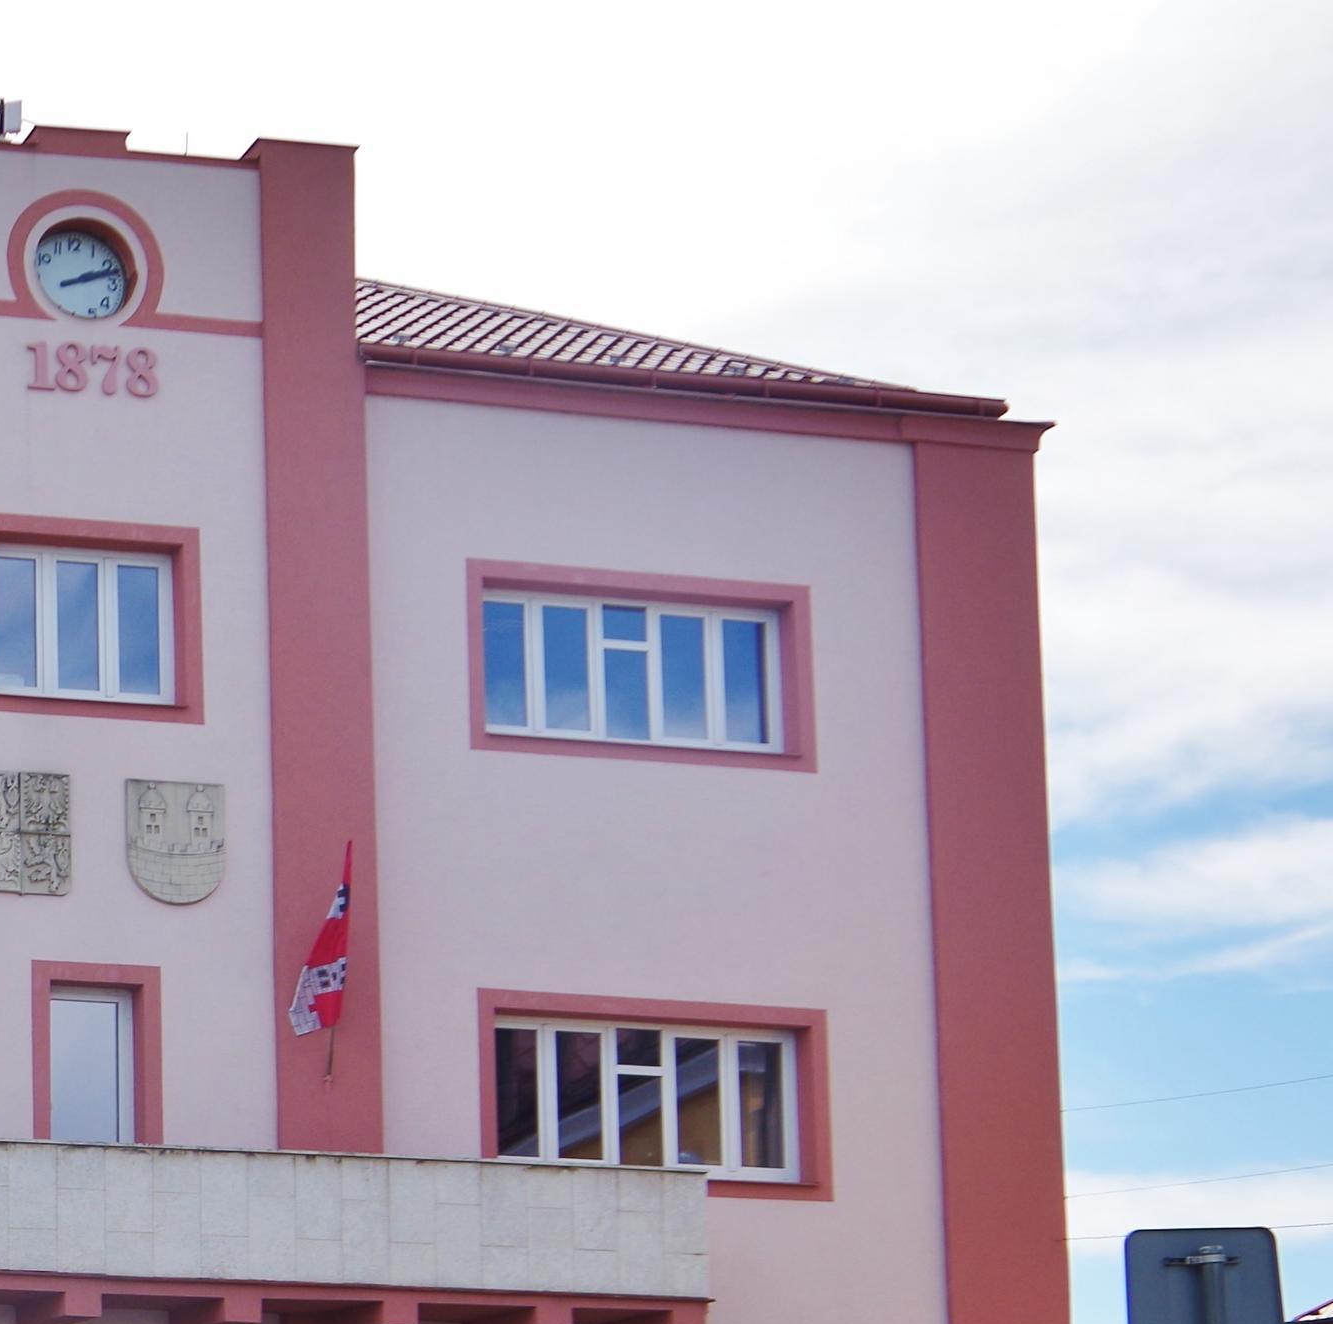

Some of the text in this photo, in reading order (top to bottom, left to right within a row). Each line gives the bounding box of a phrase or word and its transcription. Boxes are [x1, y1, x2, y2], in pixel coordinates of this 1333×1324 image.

[53, 240, 62, 255] 11
[68, 238, 82, 252] 12
[91, 244, 95, 258] 1
[37, 252, 51, 266] 10
[107, 277, 118, 292] 3
[100, 295, 110, 310] 4
[26, 341, 160, 398] 1878
